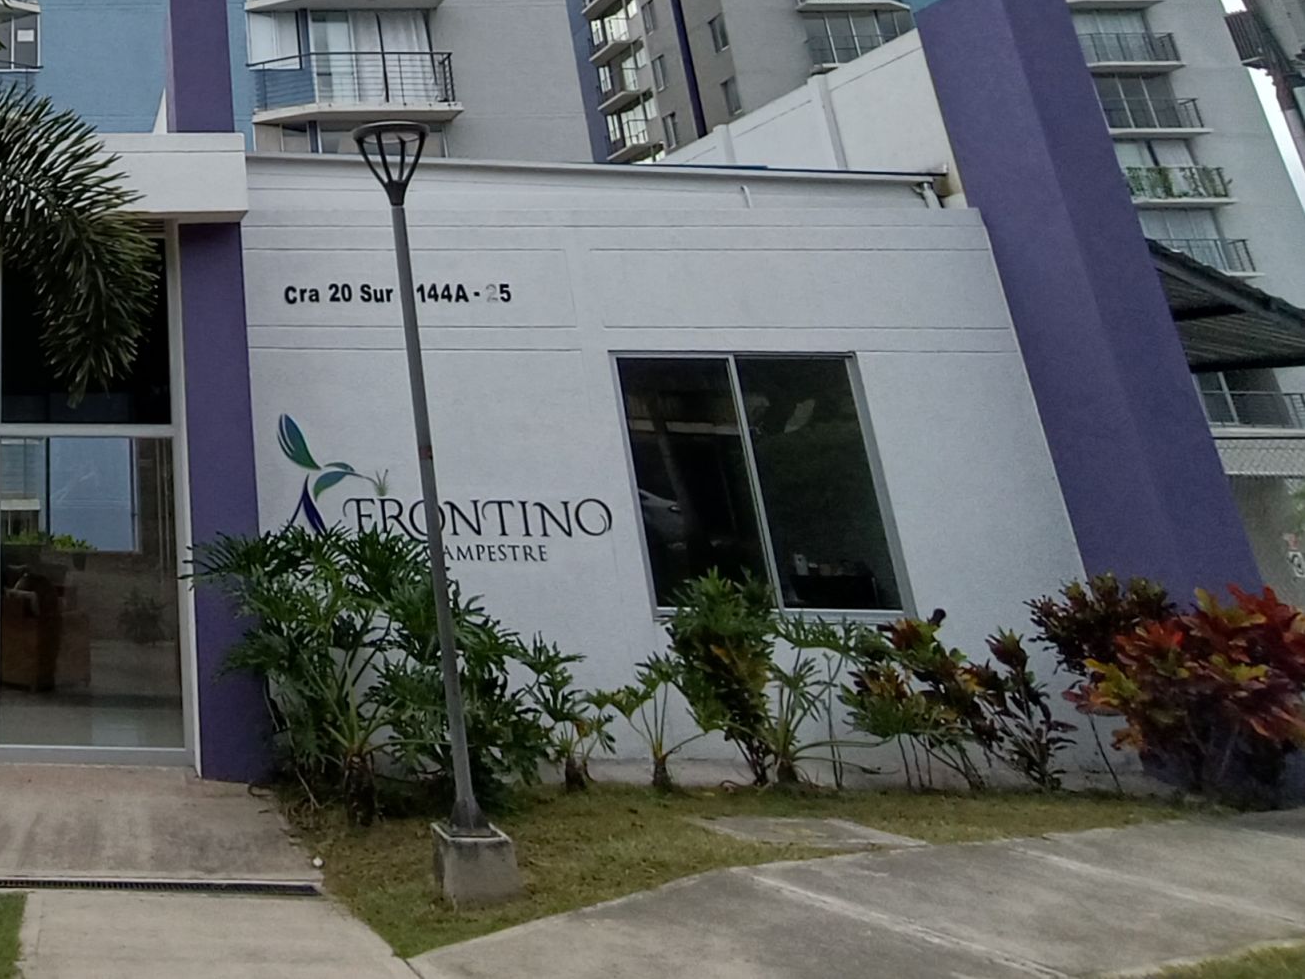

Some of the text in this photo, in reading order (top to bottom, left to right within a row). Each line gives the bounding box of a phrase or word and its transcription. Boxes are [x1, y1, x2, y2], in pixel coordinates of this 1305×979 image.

[284, 285, 320, 305] Cra
[328, 283, 353, 303] 20
[360, 283, 394, 303] Sur
[342, 497, 613, 543] FRONTINO
[425, 543, 548, 562] AMPESTRE
